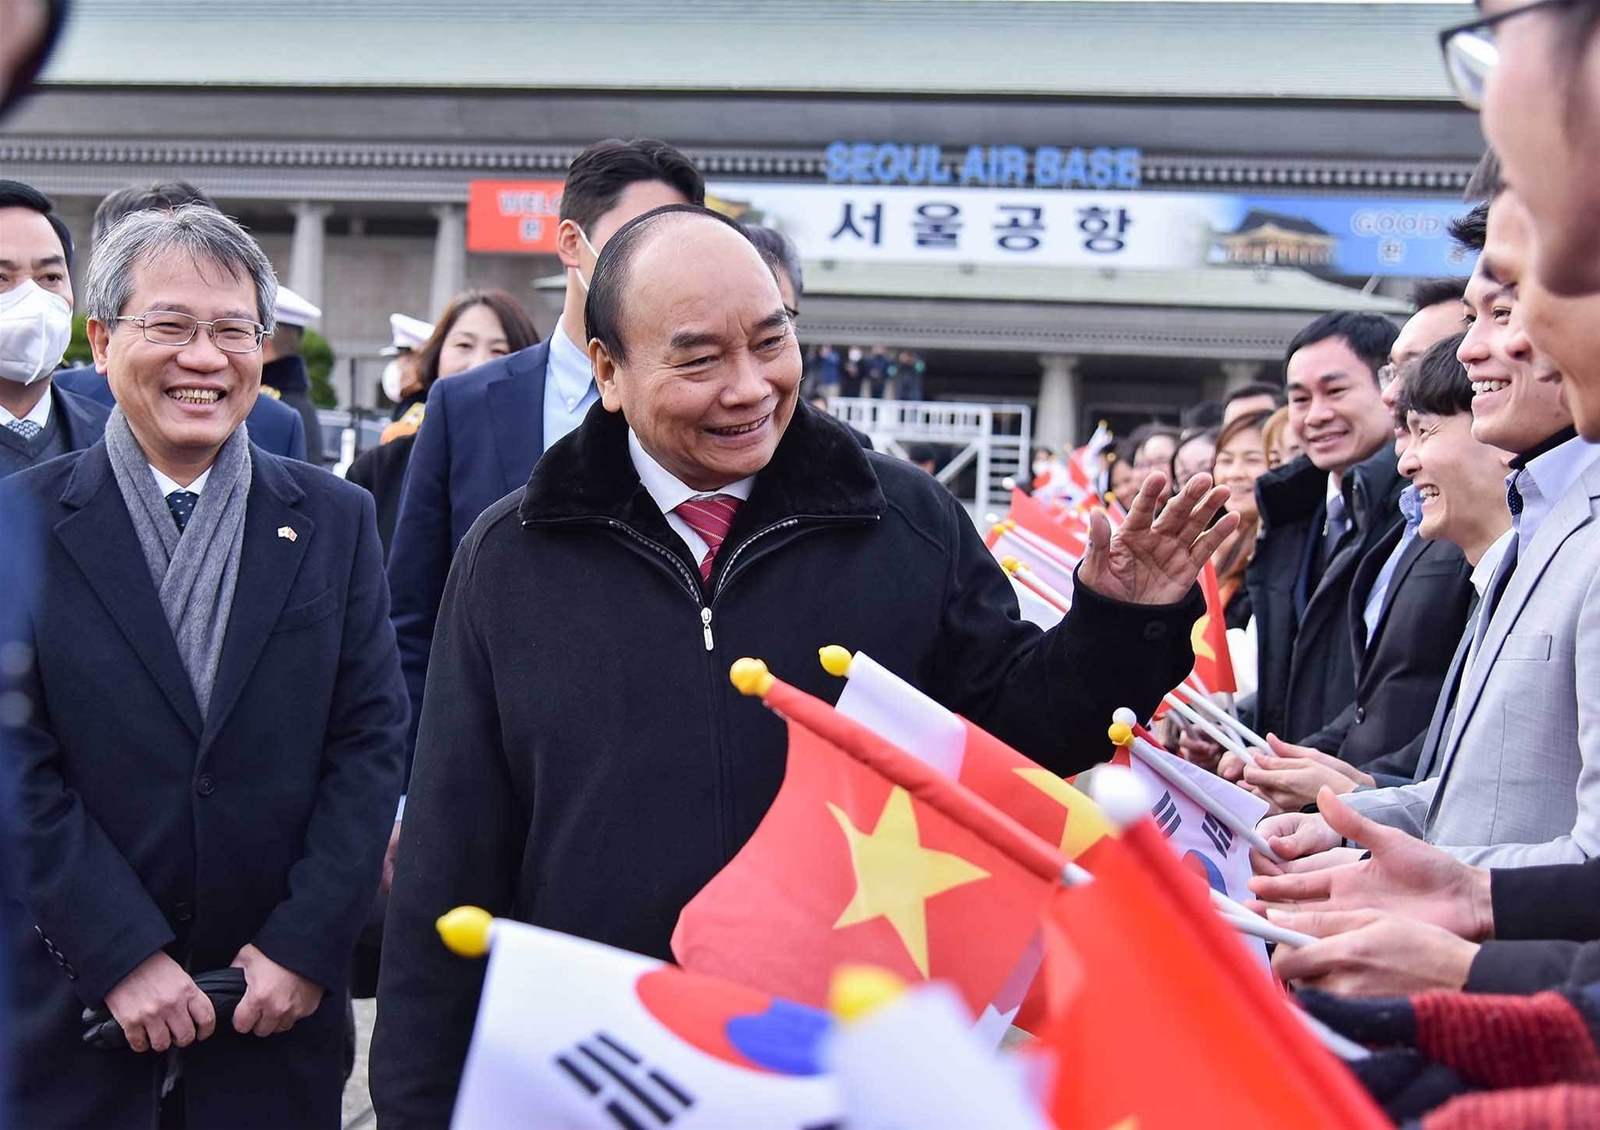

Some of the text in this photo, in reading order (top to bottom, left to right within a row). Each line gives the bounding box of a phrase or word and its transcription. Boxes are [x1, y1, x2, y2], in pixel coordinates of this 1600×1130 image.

[826, 141, 1141, 188] SEOUL AIR BASE
[831, 202, 1132, 252] 서울공항
